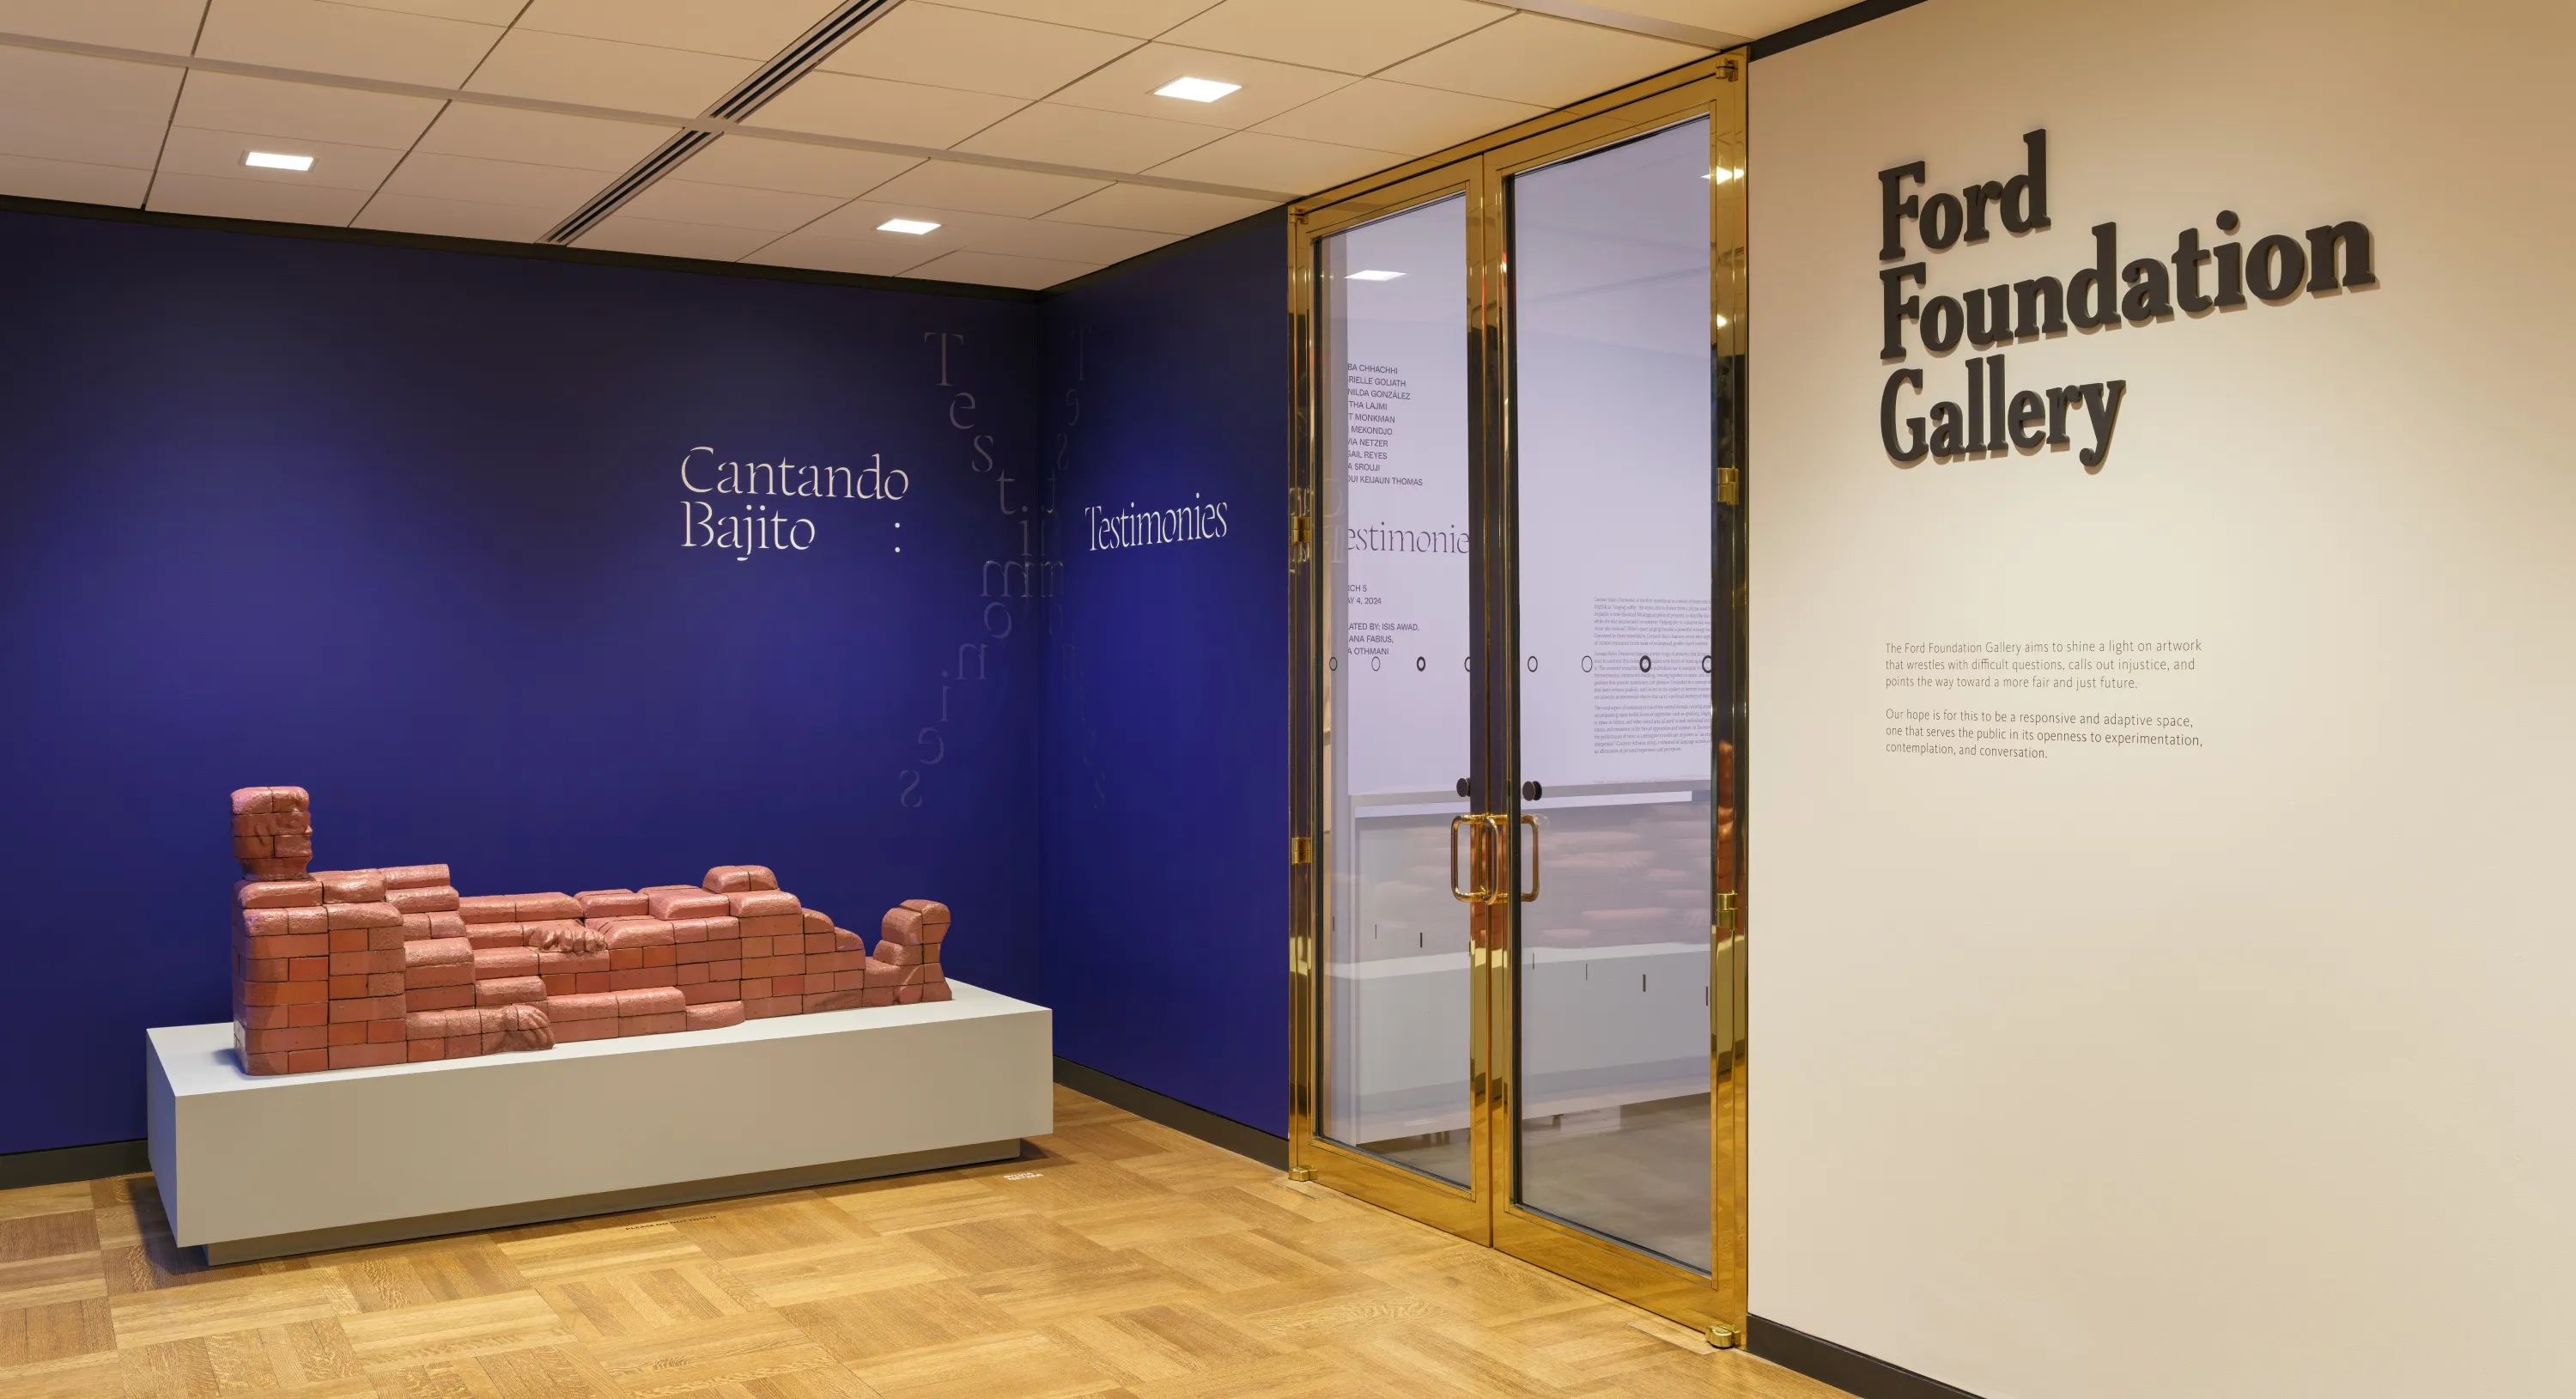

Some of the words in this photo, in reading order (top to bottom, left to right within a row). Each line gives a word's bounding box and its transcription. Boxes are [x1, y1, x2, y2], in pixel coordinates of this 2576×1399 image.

[1879, 128, 2051, 262] Ford
[1880, 210, 2376, 359] Foundation
[1359, 364, 1398, 374] CHHACHHI
[1374, 378, 1406, 387] GOLIATH
[1371, 389, 1411, 400] GONZÁLEZ
[1365, 401, 1388, 411] LAJMI
[1880, 354, 2127, 467] Gallery
[1355, 413, 1395, 423] MONKMAN
[1351, 425, 1393, 435] MEKONDJO
[1359, 438, 1388, 447] NETZER
[1364, 451, 1388, 460] REYES
[1354, 463, 1381, 471] SROUJI
[682, 447, 909, 501] Cantando
[1359, 476, 1390, 484] KEIJAUN
[1391, 477, 1424, 486] THOMAS
[1084, 492, 1229, 551] Testimonies
[682, 500, 817, 562] Bajito
[1362, 584, 1367, 593] 5
[1356, 597, 1363, 606] 4,
[1382, 623, 1395, 631] ISIS
[1396, 623, 1419, 632] AWAD,
[1366, 635, 1394, 643] FABIUS,
[1353, 647, 1389, 655] OTHMANI
[1886, 643, 1901, 653] The
[1905, 642, 1924, 653] Ford
[1929, 642, 1982, 653] Foundation
[1986, 642, 2021, 655] Gallery
[2024, 642, 2049, 653] aims
[2052, 642, 2064, 652] to
[2066, 641, 2095, 653] shine
[2110, 640, 2134, 654] light
[2157, 639, 2202, 652] artwork
[1886, 660, 1904, 670] that
[1907, 659, 1945, 670] wrestles
[1947, 660, 1968, 670] with
[1971, 658, 2009, 670] difficult
[2013, 660, 2064, 672] questions,
[2069, 658, 2092, 670] calls
[2096, 660, 2115, 670] out
[2119, 657, 2169, 673] injustice,
[2174, 658, 2194, 670] and
[1886, 677, 1914, 689] points
[1917, 676, 1934, 686] the
[1934, 677, 1953, 690] way
[1956, 676, 1990, 687] toward
[2031, 676, 2050, 687] fair
[2054, 677, 2072, 687] and
[2076, 677, 2096, 690] just
[2100, 676, 2137, 690] future.
[1886, 709, 1905, 719] Our
[1907, 709, 1929, 722] hope
[1934, 710, 1940, 721] is
[1943, 709, 1957, 721] for
[1959, 710, 1979, 721] this
[1981, 712, 1992, 721] to
[1996, 711, 2007, 721] be
[2020, 713, 2076, 726] responsive
[2080, 713, 2099, 725] and
[2104, 713, 2152, 727] adaptive
[2157, 717, 2192, 728] space,
[1905, 726, 1923, 737] that
[1927, 728, 1955, 738] serves
[1958, 727, 1974, 738] the
[1976, 727, 2006, 741] public
[2010, 729, 2019, 740] in
[2023, 729, 2033, 741] its
[2038, 732, 2087, 743] openness
[2090, 732, 2102, 742] to
[2105, 733, 2202, 746] experimentation,
[1886, 742, 1955, 756] contemplation,
[1959, 745, 1976, 756] and
[1978, 745, 2047, 758] conversation.
